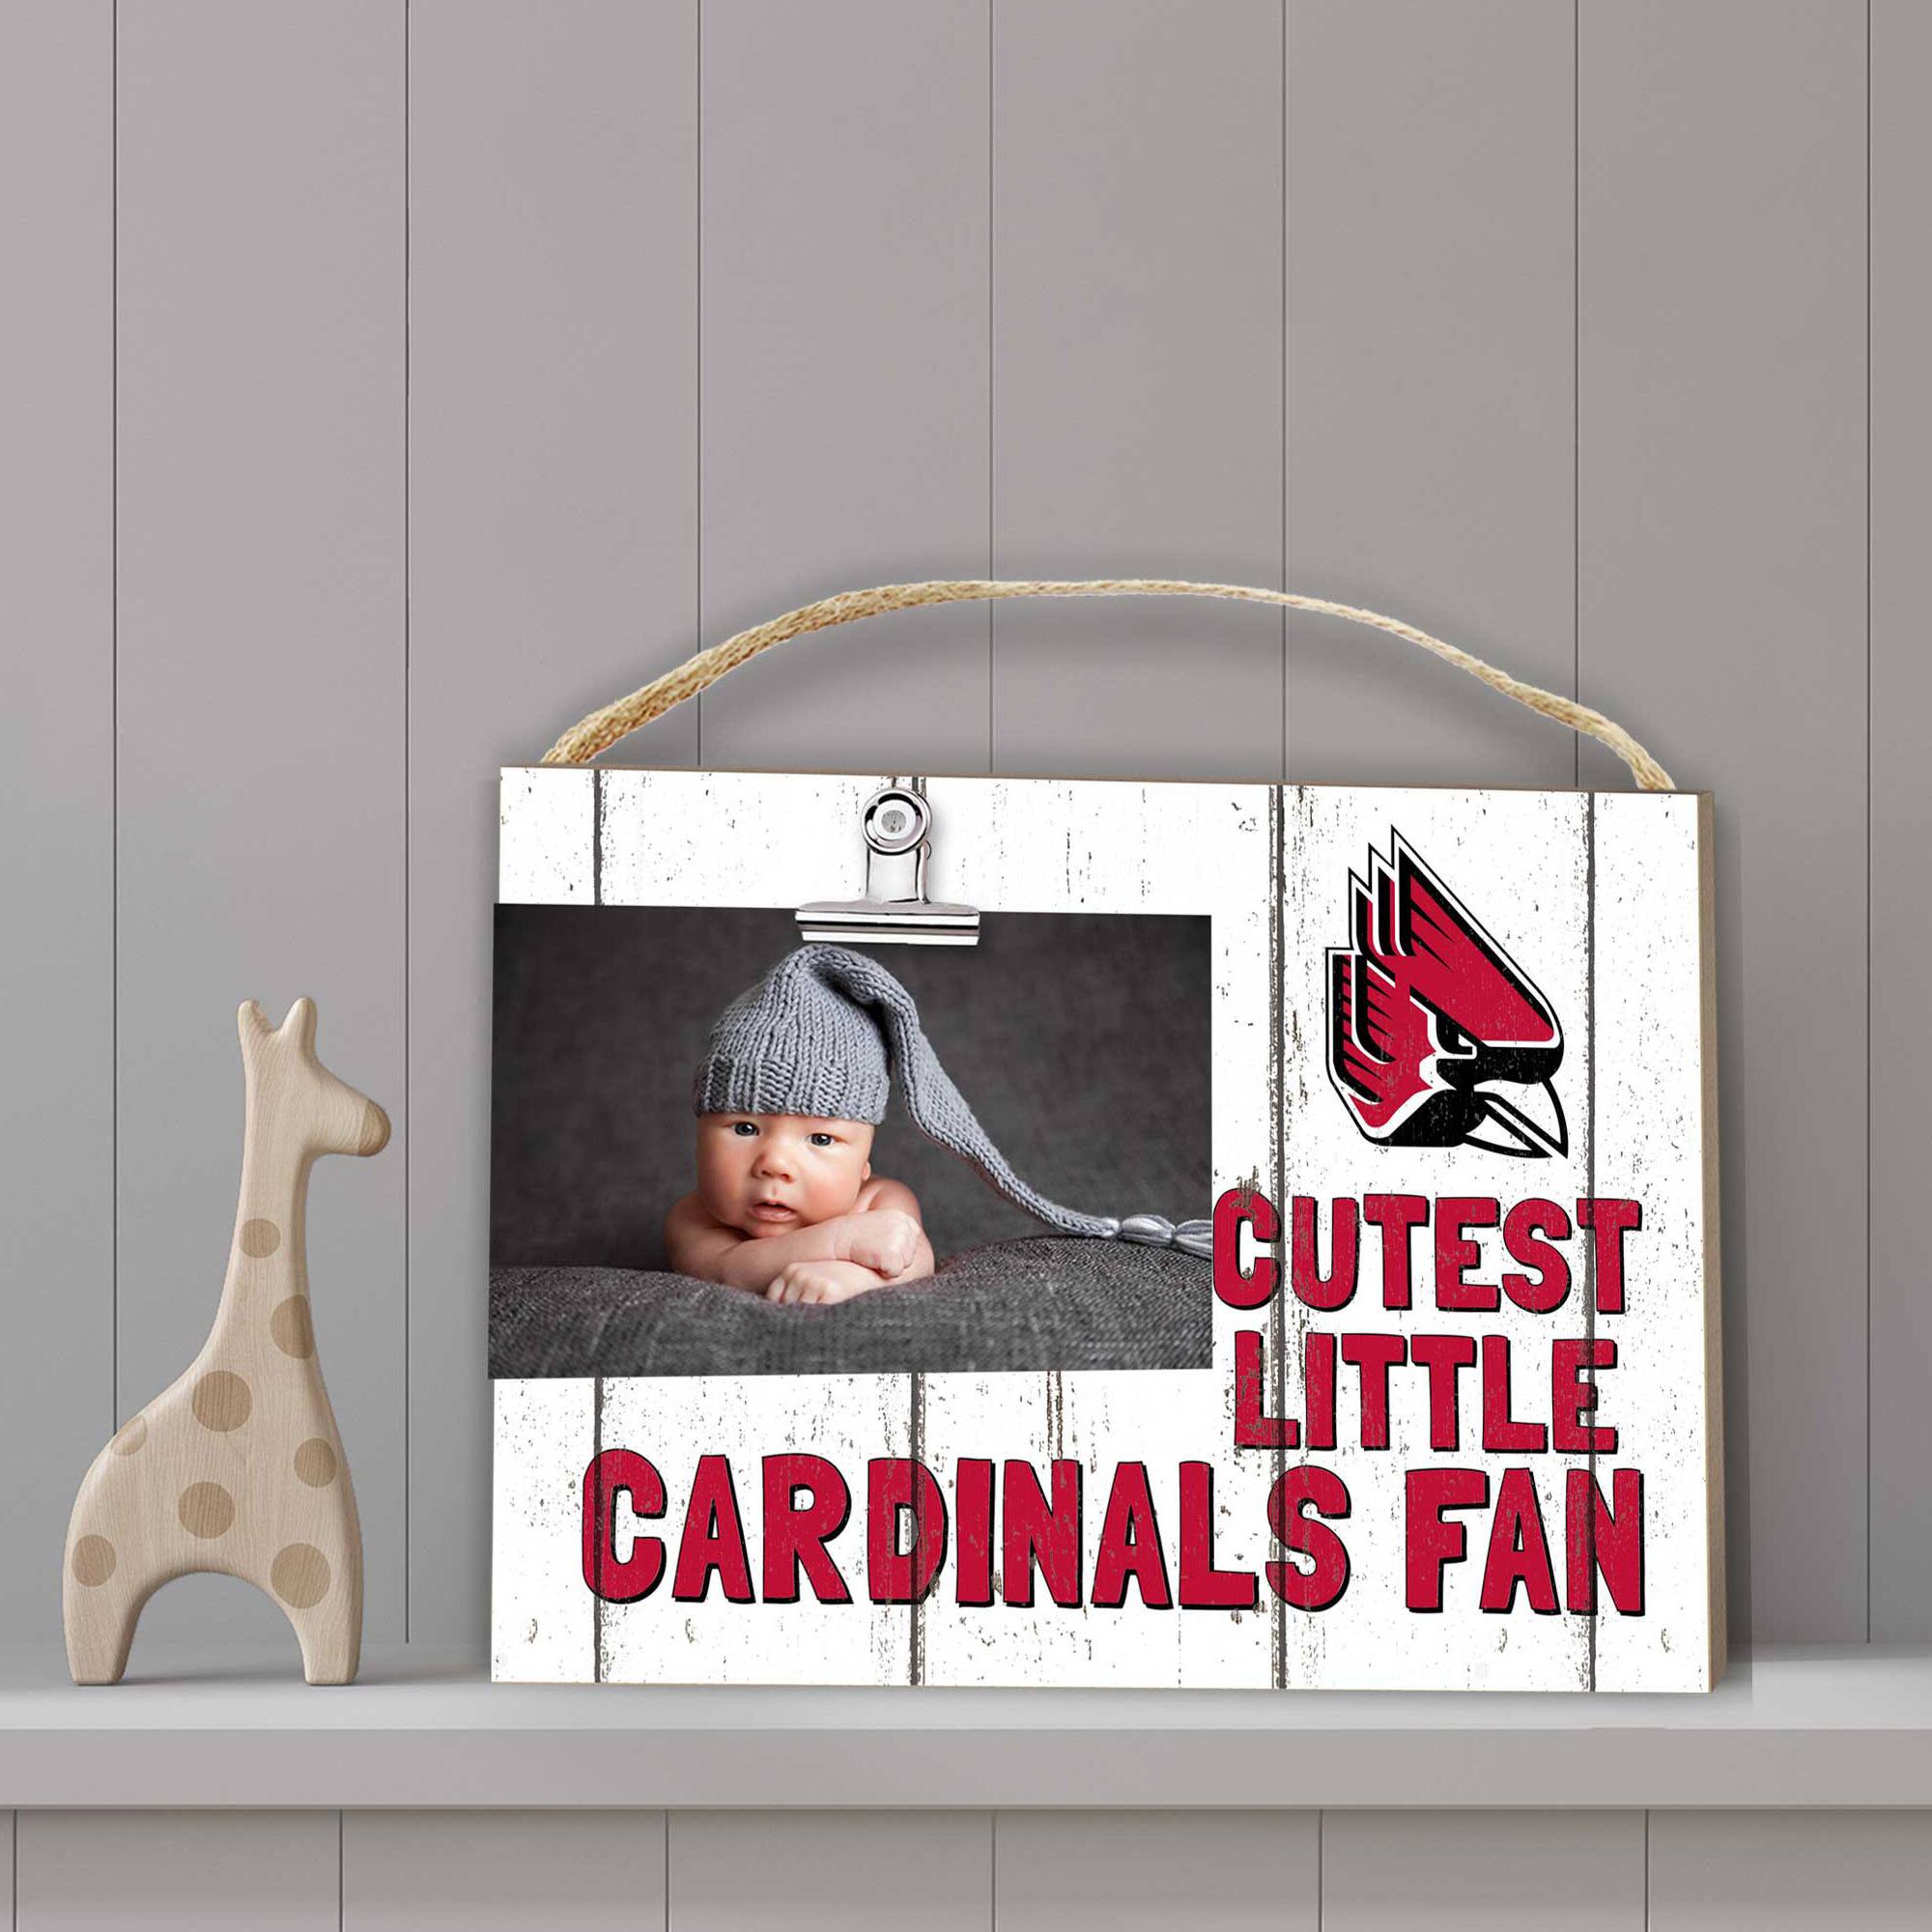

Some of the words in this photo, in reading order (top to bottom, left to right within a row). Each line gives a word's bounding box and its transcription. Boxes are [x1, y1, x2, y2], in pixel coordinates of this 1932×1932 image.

[1212, 1188, 1642, 1314] CUTEST
[1234, 1330, 1618, 1454] LITTLE
[582, 1448, 1351, 1612] CARDINALS
[1405, 1467, 1645, 1616] FAN
